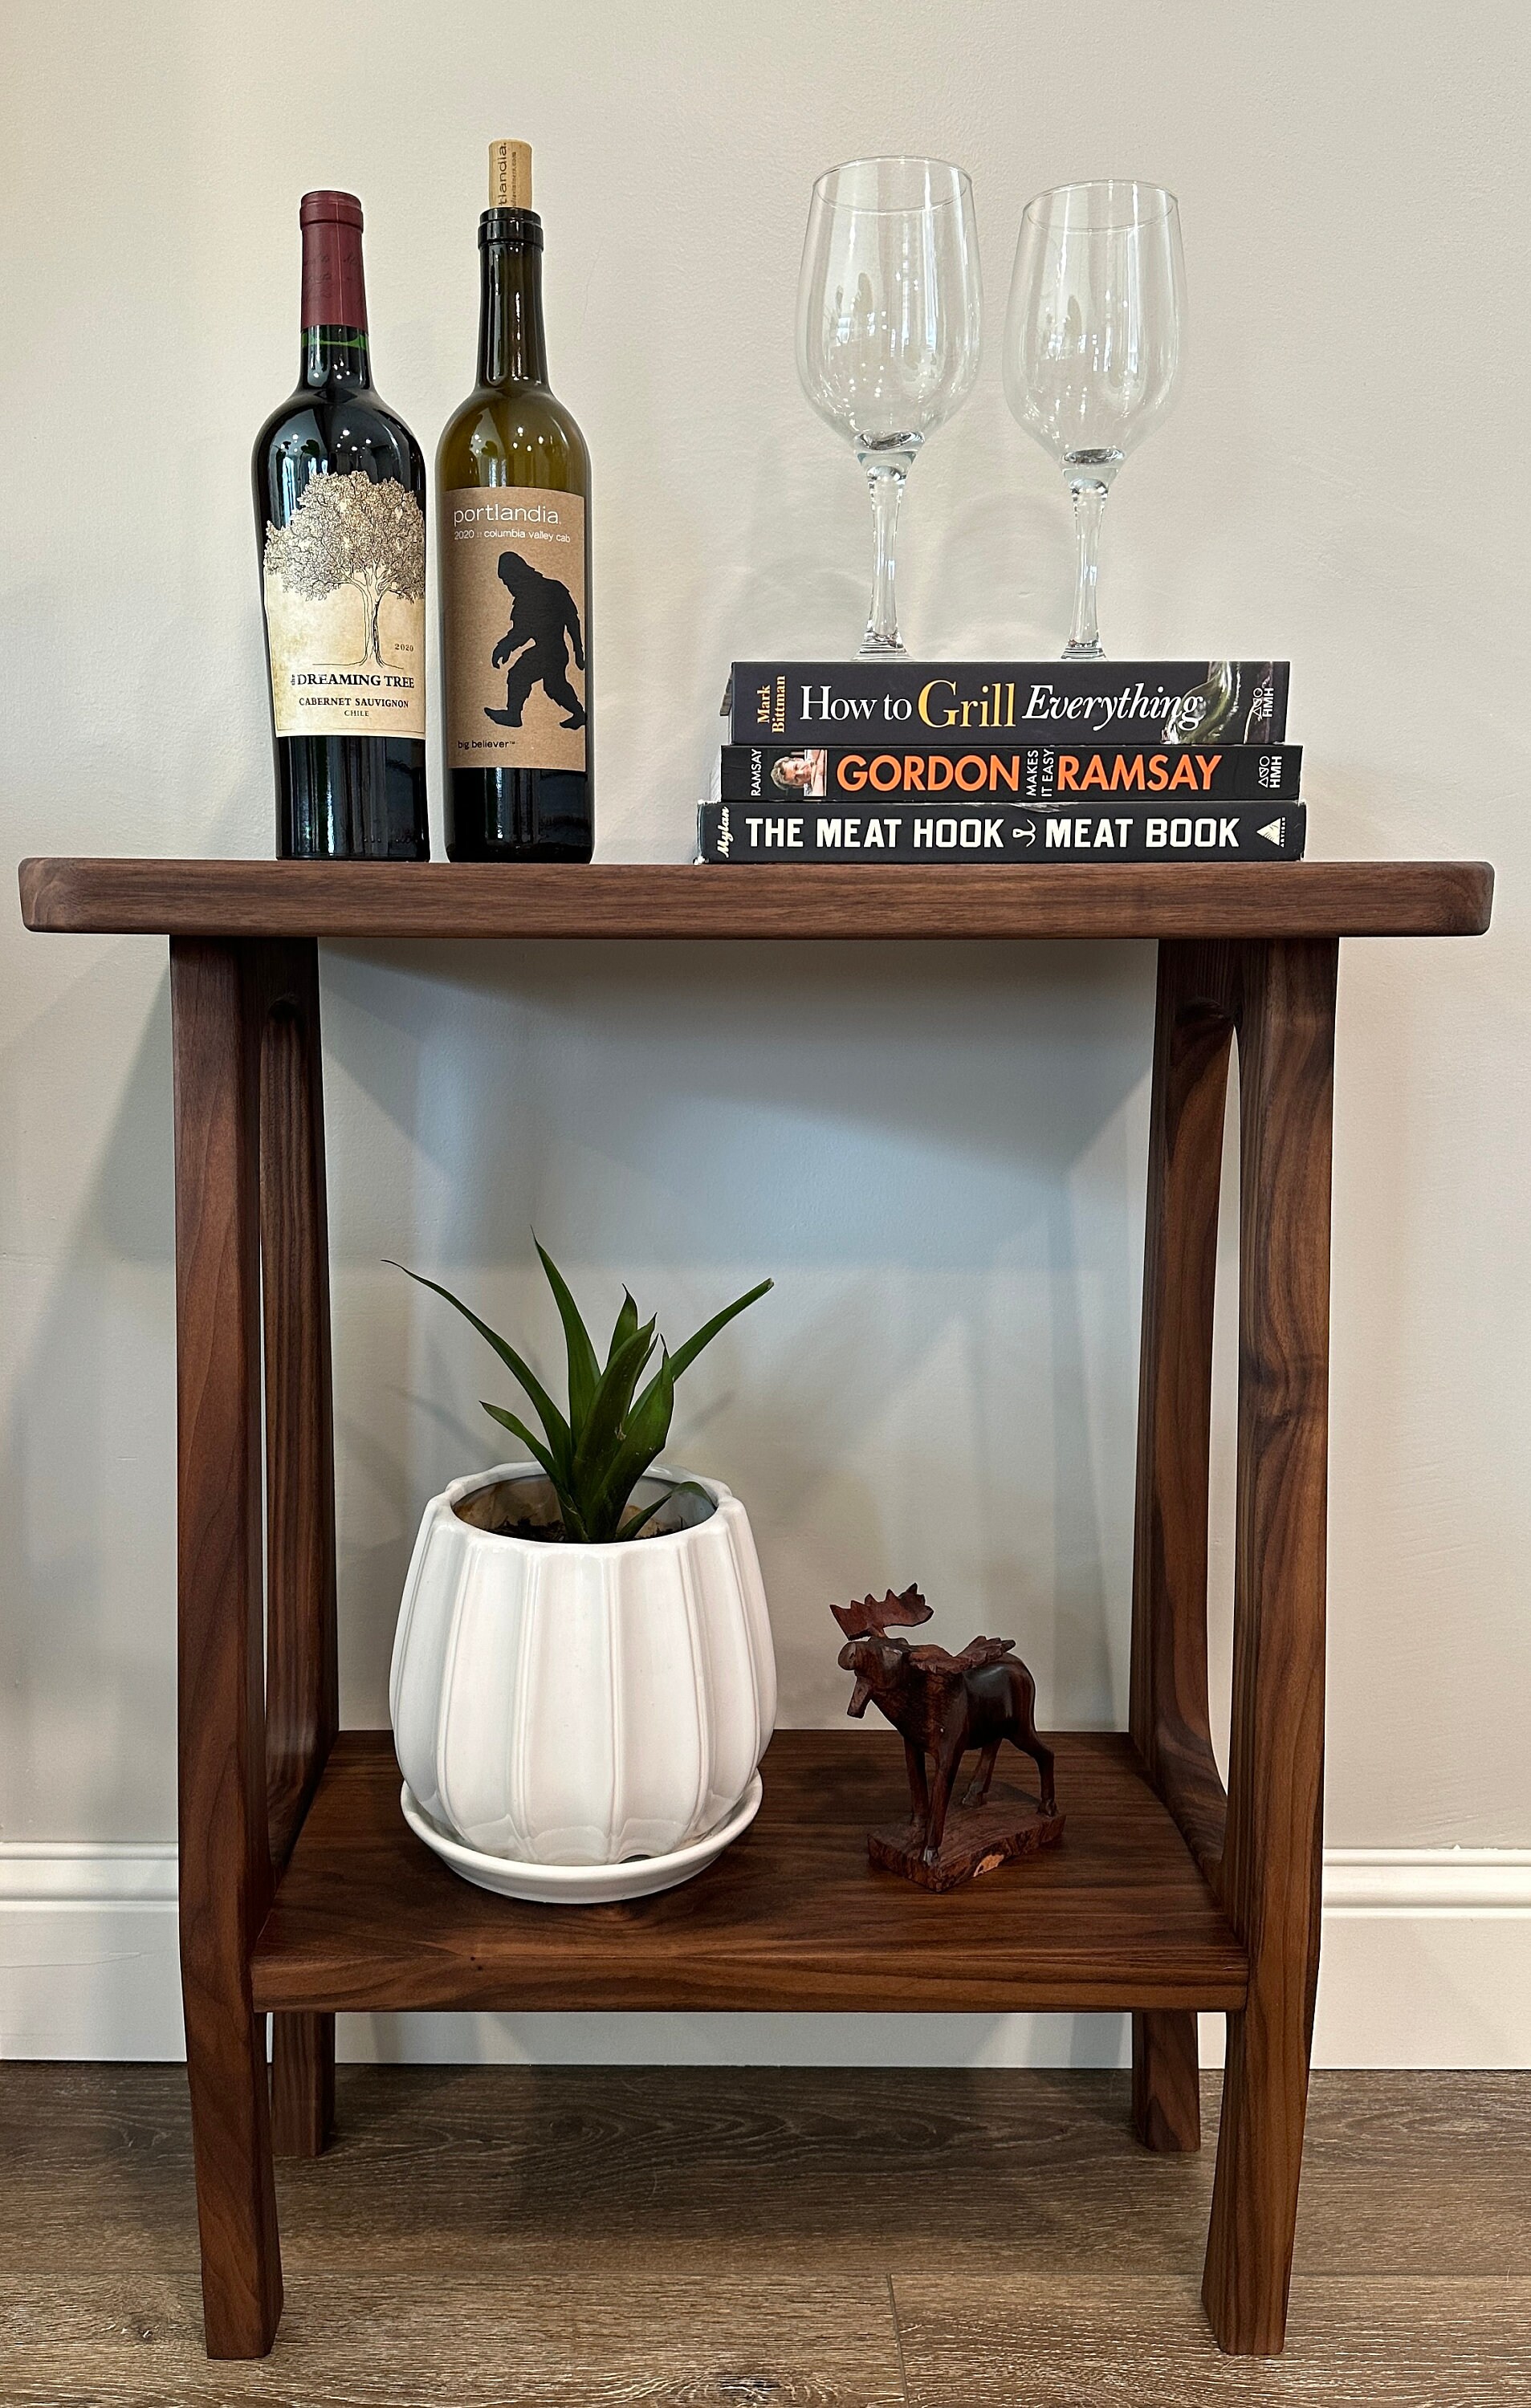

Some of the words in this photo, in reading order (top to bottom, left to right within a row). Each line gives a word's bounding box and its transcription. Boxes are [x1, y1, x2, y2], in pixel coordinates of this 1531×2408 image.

[454, 530, 474, 539] 2020
[484, 529, 526, 539] columbia
[528, 531, 554, 542] valley
[556, 534, 571, 543] cab
[297, 673, 381, 686] DREAMING
[384, 675, 415, 689] TREE
[299, 698, 352, 706] CABERNET
[355, 698, 409, 708] SAUVIGNON
[757, 685, 771, 724] Mark
[772, 675, 786, 733] Bittman
[800, 685, 877, 721] How
[883, 694, 912, 721] to
[917, 679, 1016, 728] Grill
[1021, 682, 1205, 732] Everything
[1262, 687, 1274, 718] HMH
[751, 748, 762, 796] RAMSAY
[837, 755, 1020, 791] GORDON
[1025, 750, 1039, 796] MAKES
[1042, 748, 1054, 783] EASY
[1057, 755, 1222, 791] RAMSAY
[1269, 756, 1282, 788] HMH
[1041, 784, 1053, 797] IT
[717, 806, 731, 858] Mylan
[745, 818, 804, 848] THE
[816, 818, 902, 848] MEAT
[913, 818, 1004, 848] HOOK
[1045, 818, 1134, 848] MEAT
[1146, 817, 1240, 848] BOOK
